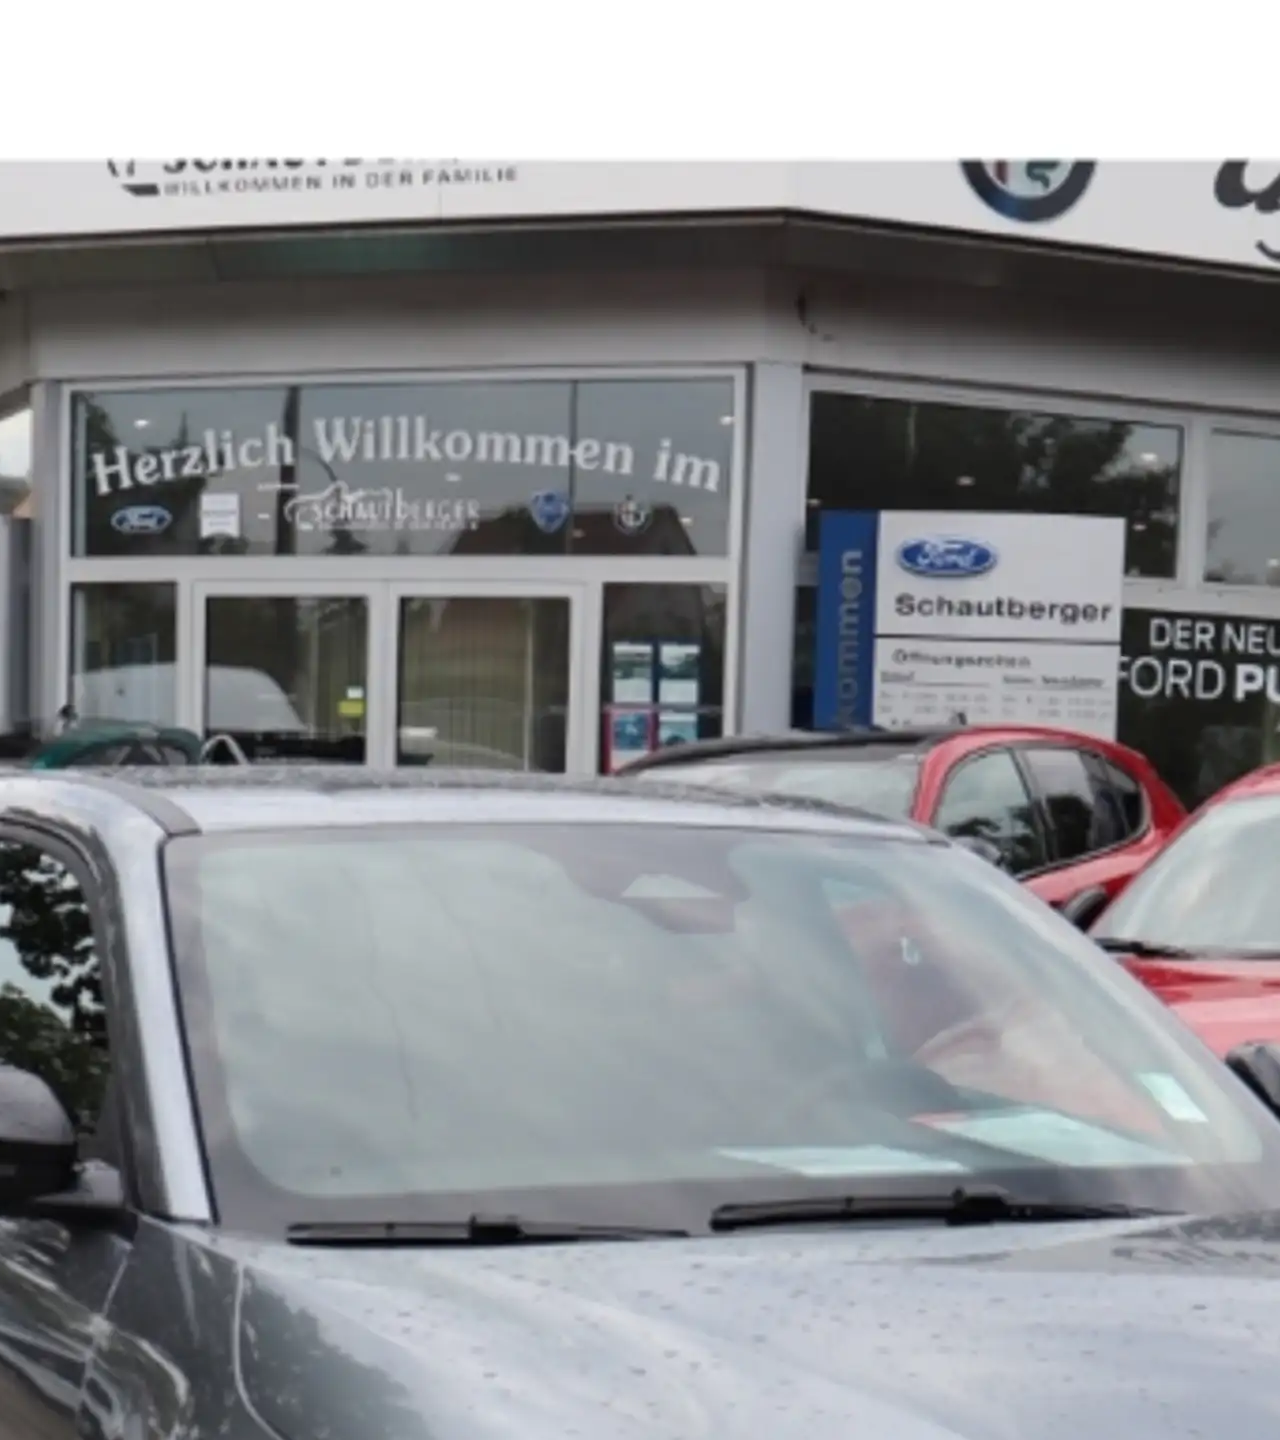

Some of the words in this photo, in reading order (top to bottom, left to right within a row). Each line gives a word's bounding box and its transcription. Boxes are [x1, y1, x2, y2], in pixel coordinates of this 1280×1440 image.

[164, 173, 323, 198] WILLKOMMEN
[332, 173, 356, 190] IN
[365, 170, 414, 188] DER
[422, 166, 518, 186] FAMILIE
[92, 424, 295, 496] Herzlich
[313, 415, 635, 475] Willkommen
[652, 438, 719, 493] im
[894, 593, 1113, 625] Schautberger
[1149, 618, 1214, 652] DER
